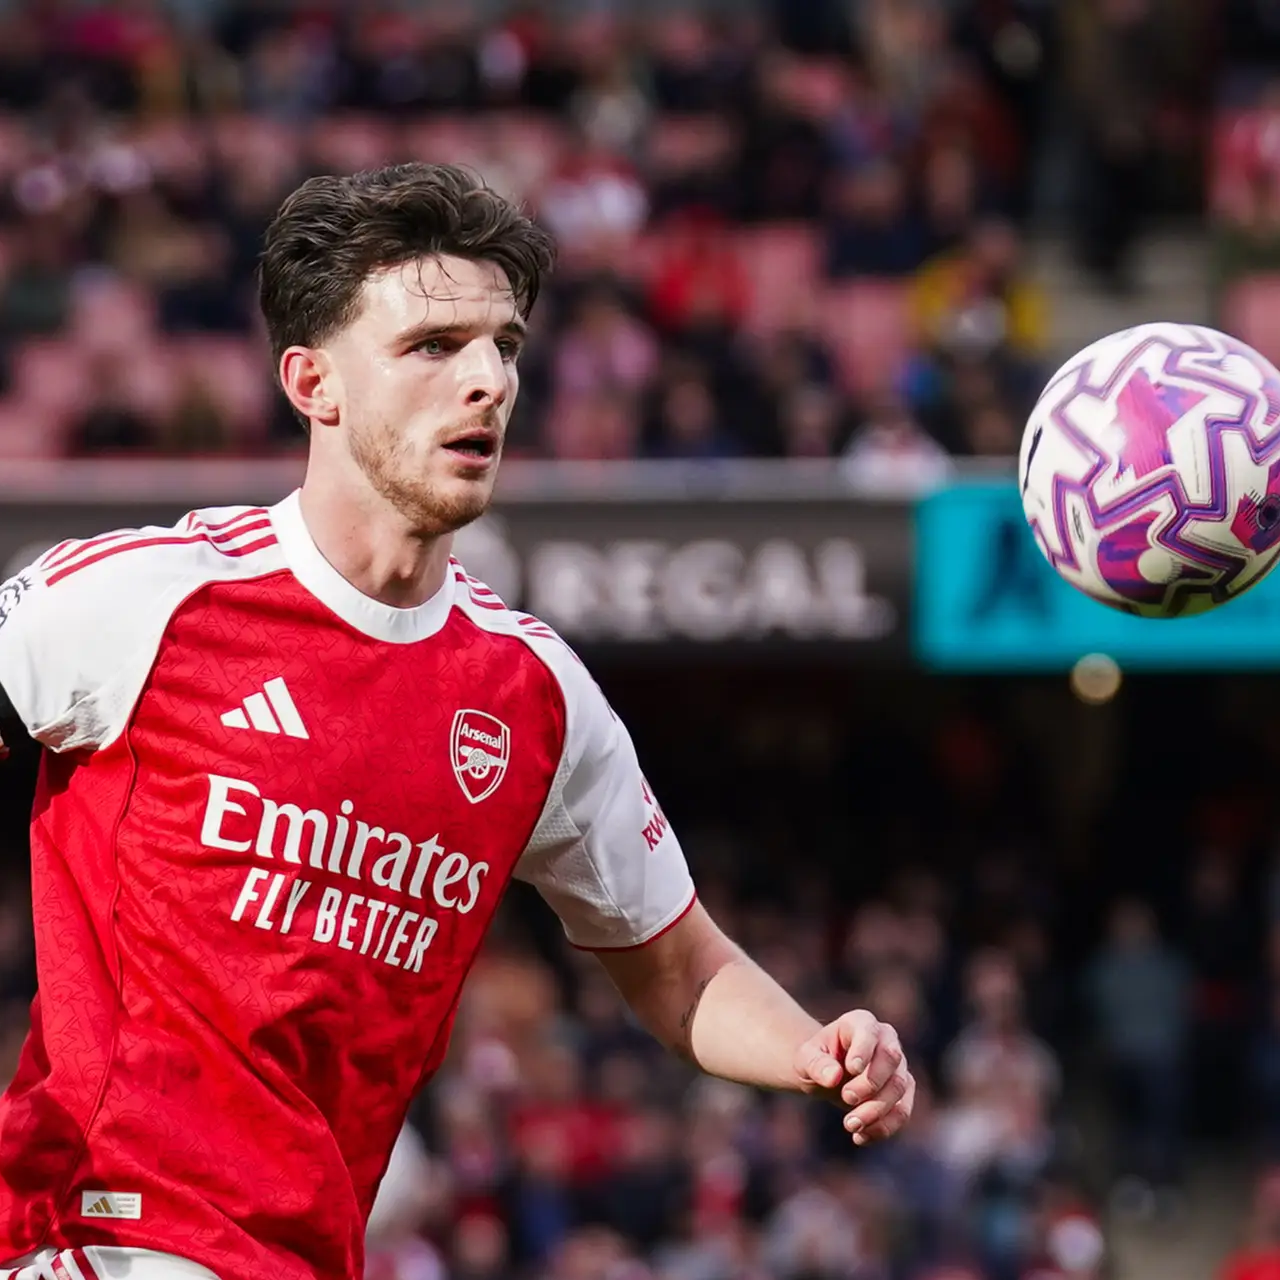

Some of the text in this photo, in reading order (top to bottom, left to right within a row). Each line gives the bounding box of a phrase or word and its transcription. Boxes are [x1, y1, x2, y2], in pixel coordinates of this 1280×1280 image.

[524, 536, 876, 642] REGAL
[460, 722, 502, 749] Arsenal
[200, 773, 490, 915] Emirates
[230, 866, 440, 974] FLY BETTER
